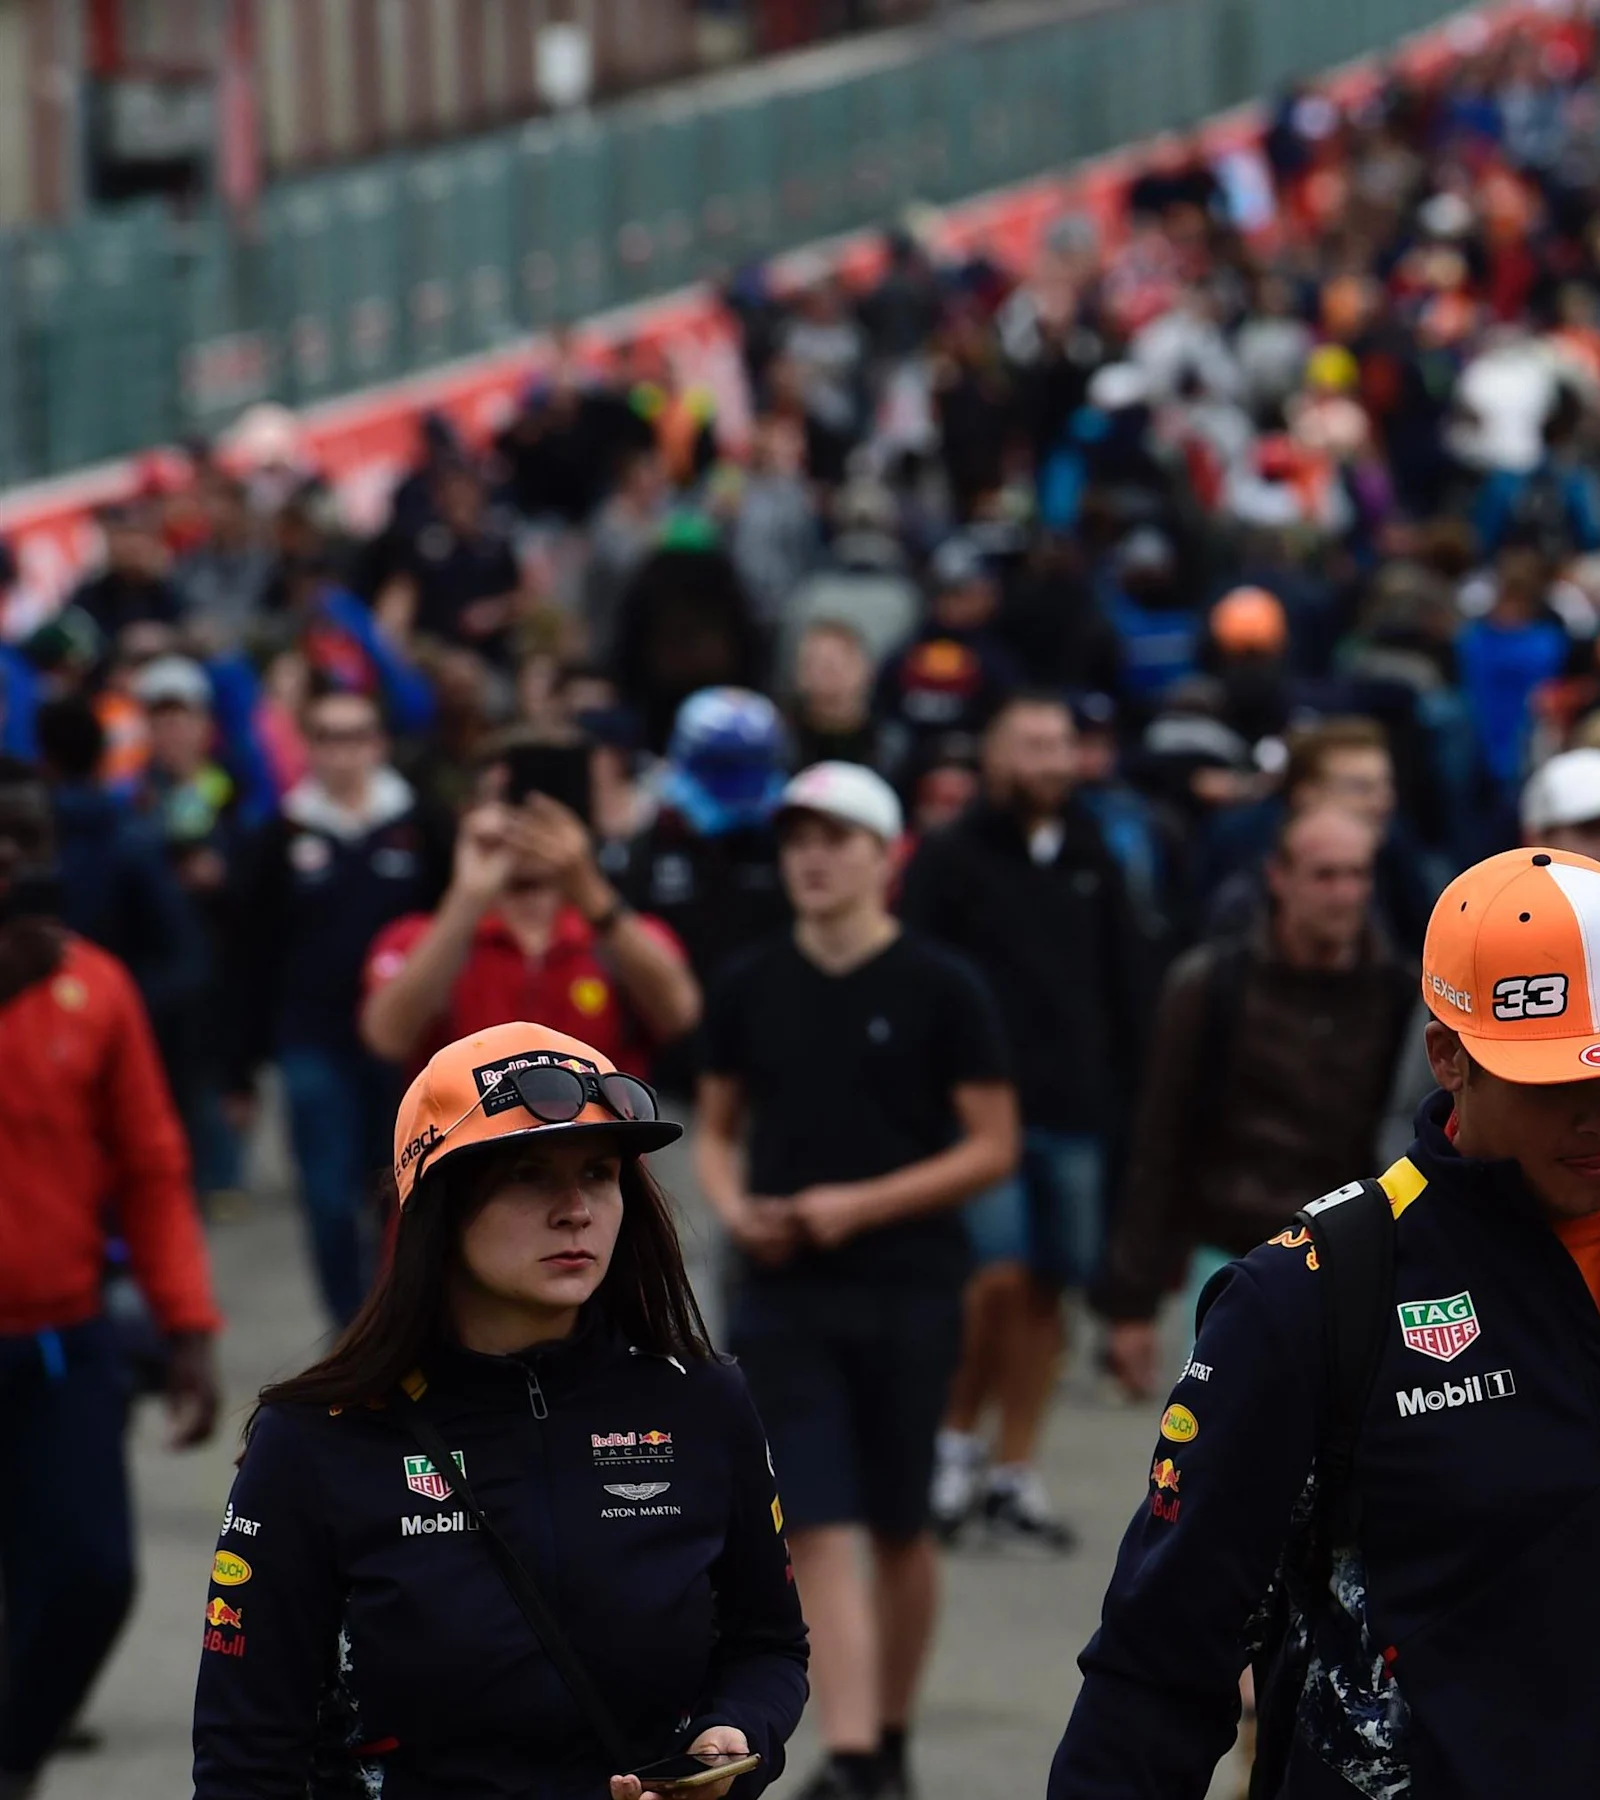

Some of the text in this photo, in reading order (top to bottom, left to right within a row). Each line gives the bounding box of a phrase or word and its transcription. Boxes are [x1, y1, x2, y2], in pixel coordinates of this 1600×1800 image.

[1433, 975, 1472, 1013] exact
[1494, 974, 1568, 1020] 33
[1404, 1298, 1468, 1325] TAG
[1408, 1320, 1475, 1357] HEUER
[1189, 1361, 1213, 1383] AT&T
[1396, 1375, 1483, 1418] Mobil
[593, 1446, 674, 1457] RACING
[401, 1511, 464, 1536] Mobil
[601, 1505, 681, 1518] ASTON MARTIN
[232, 1516, 261, 1536] AT&T
